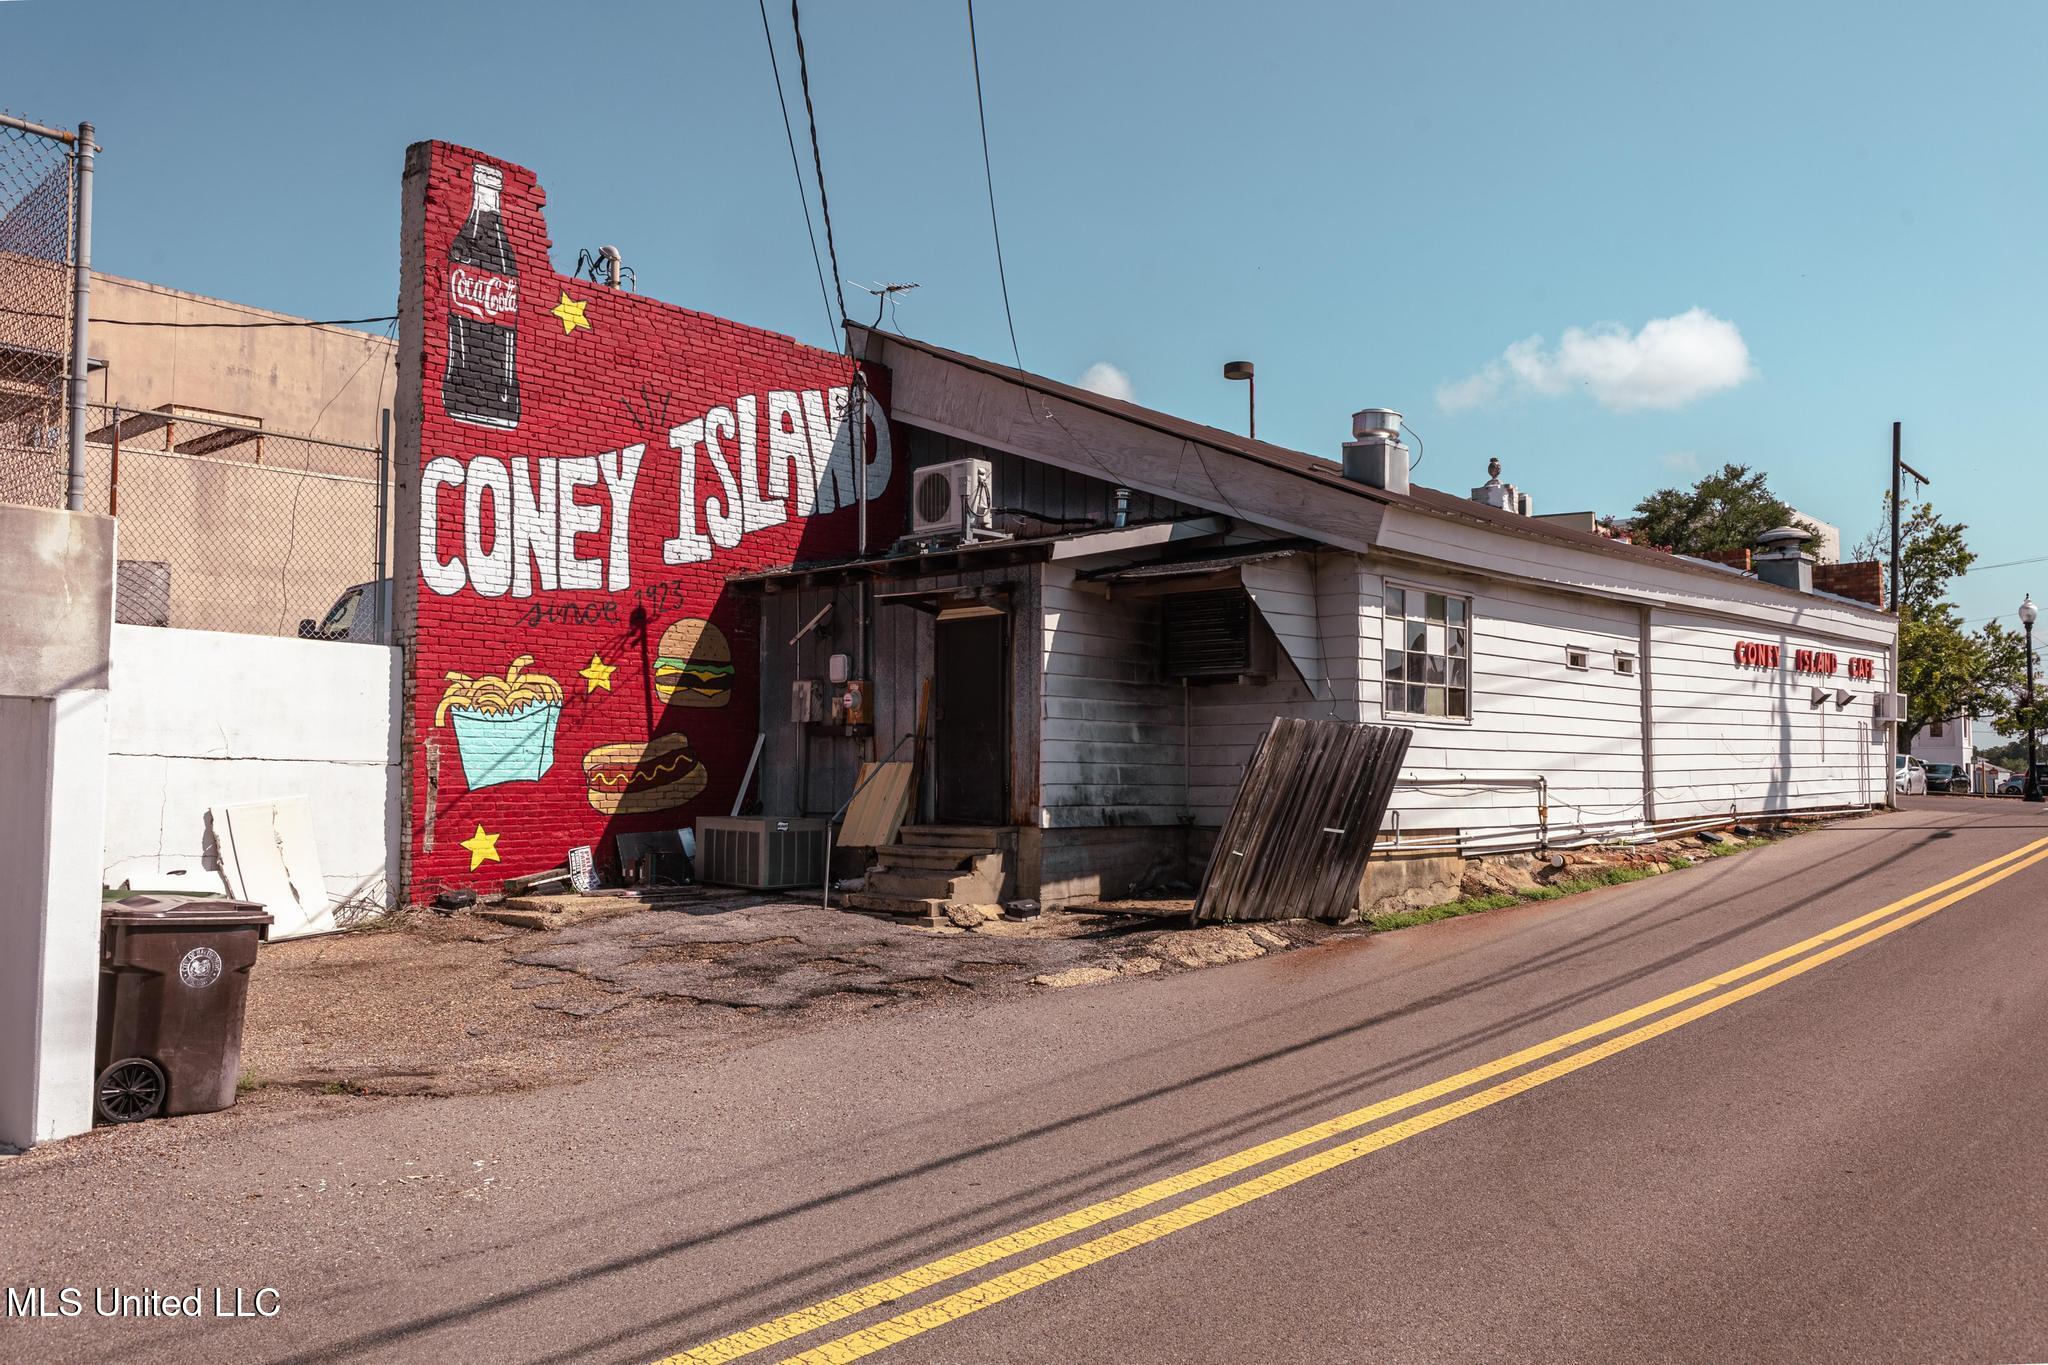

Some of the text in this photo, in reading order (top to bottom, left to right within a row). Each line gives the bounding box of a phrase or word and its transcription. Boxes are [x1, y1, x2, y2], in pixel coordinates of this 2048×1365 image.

[419, 386, 893, 599] CONEY ISLAND
[634, 580, 684, 618] 1923
[1734, 641, 1875, 680] CONEY ISLAND CAFE
